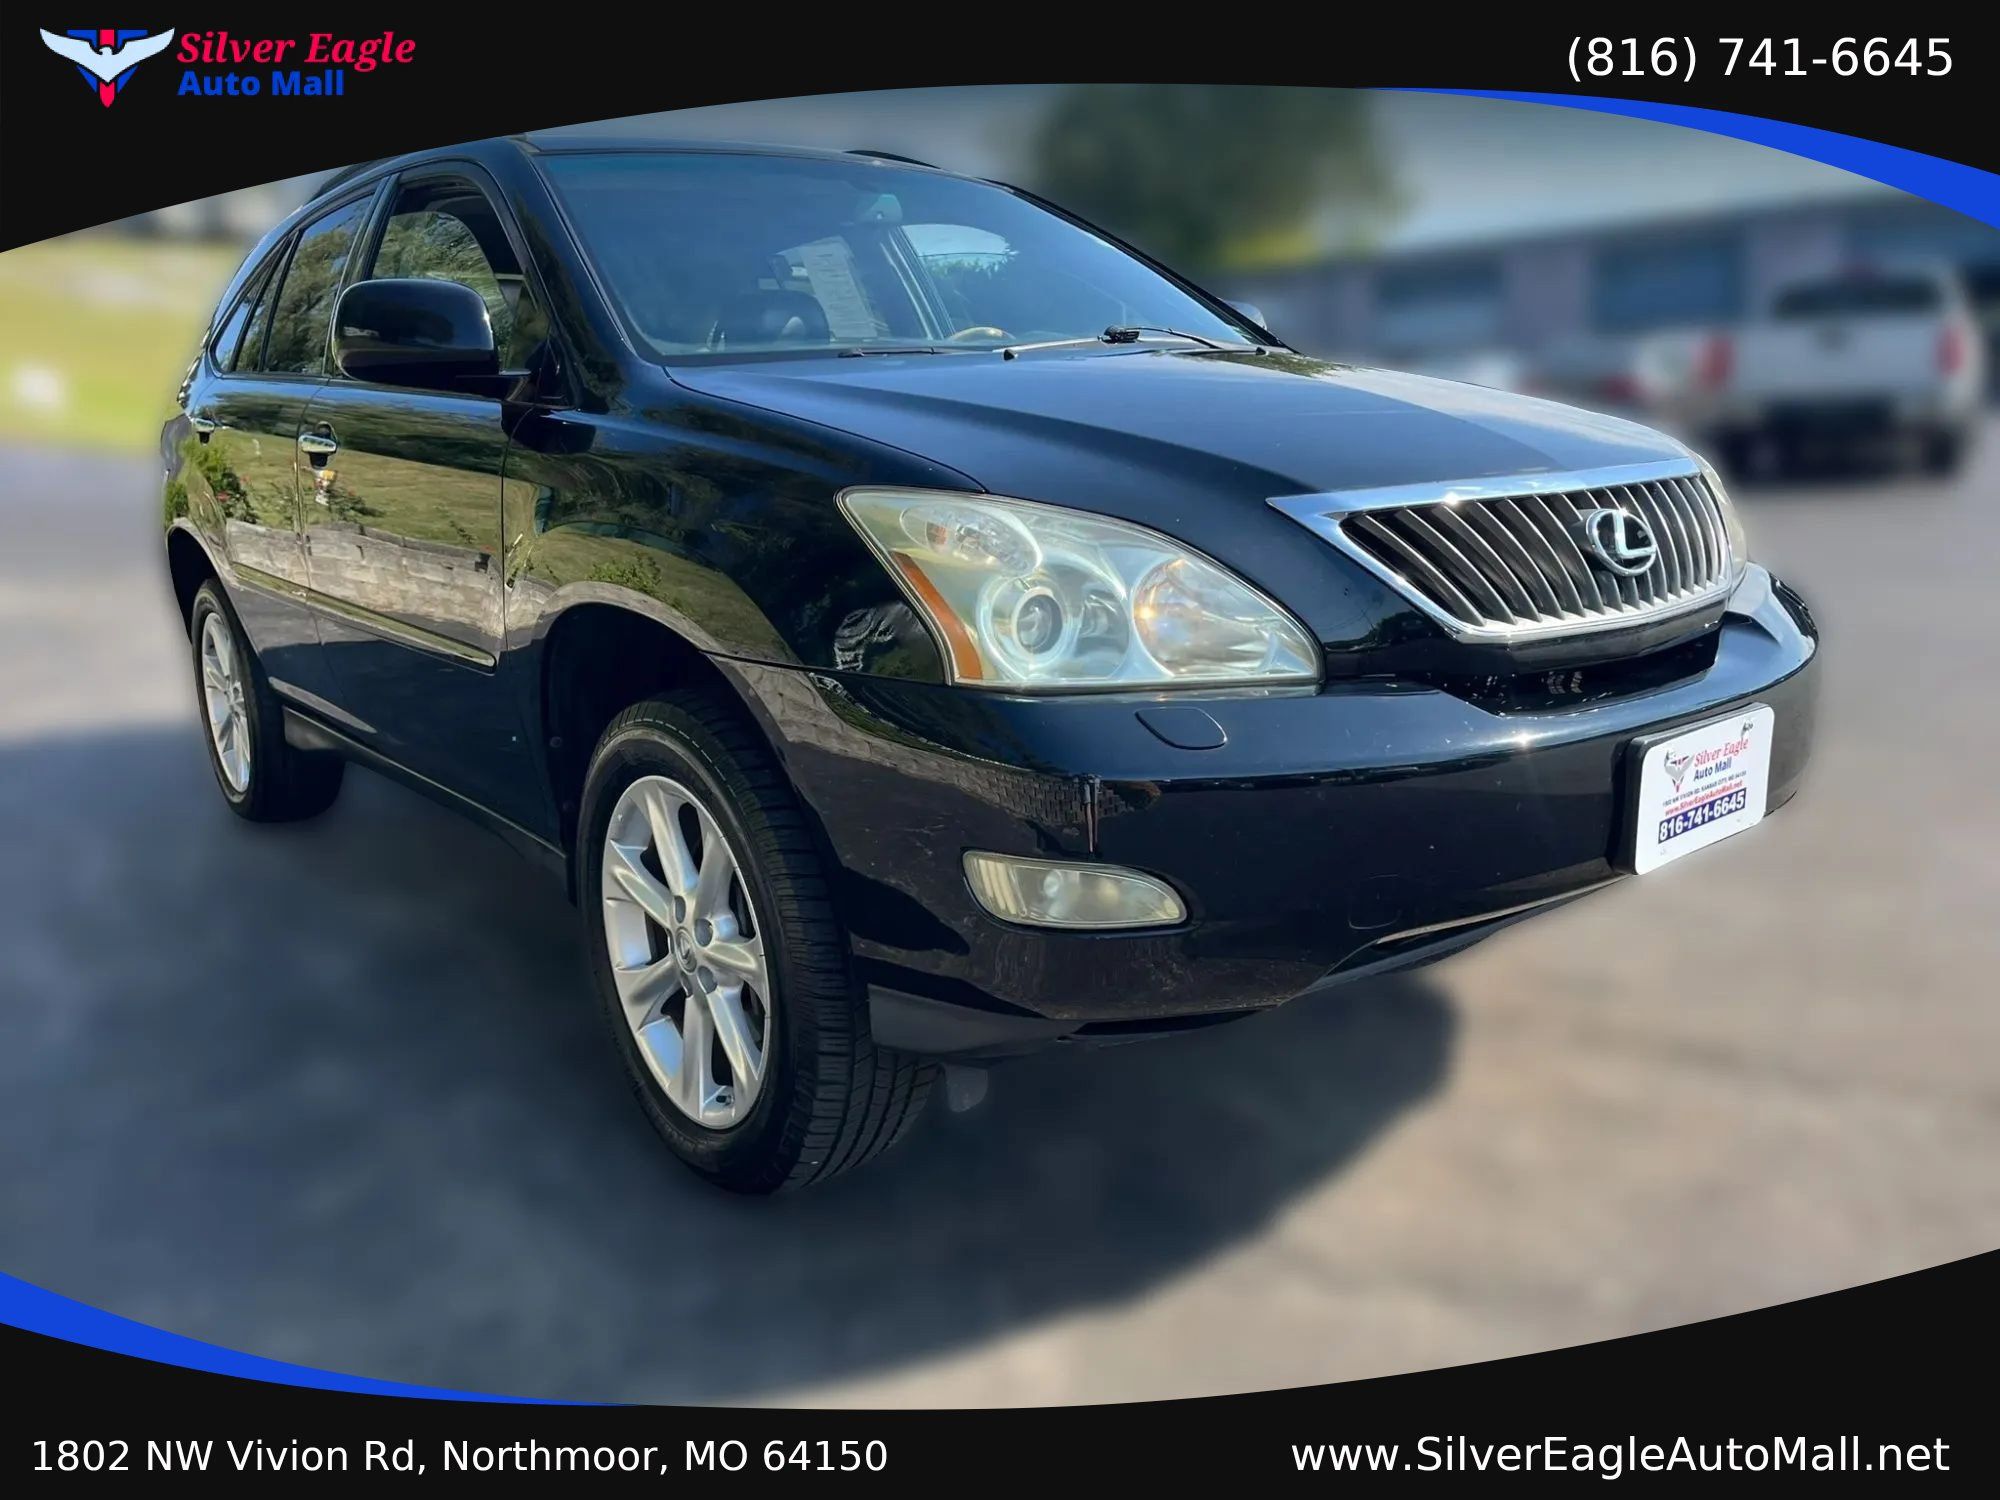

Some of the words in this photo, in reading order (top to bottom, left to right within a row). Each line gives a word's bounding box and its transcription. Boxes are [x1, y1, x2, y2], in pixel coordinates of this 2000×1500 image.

[1694, 748, 1722, 767] Silver
[1723, 738, 1749, 757] Eagle
[1693, 766, 1713, 782] Auto
[1714, 756, 1732, 774] Mall
[1659, 790, 1746, 842] 816-741-6645
